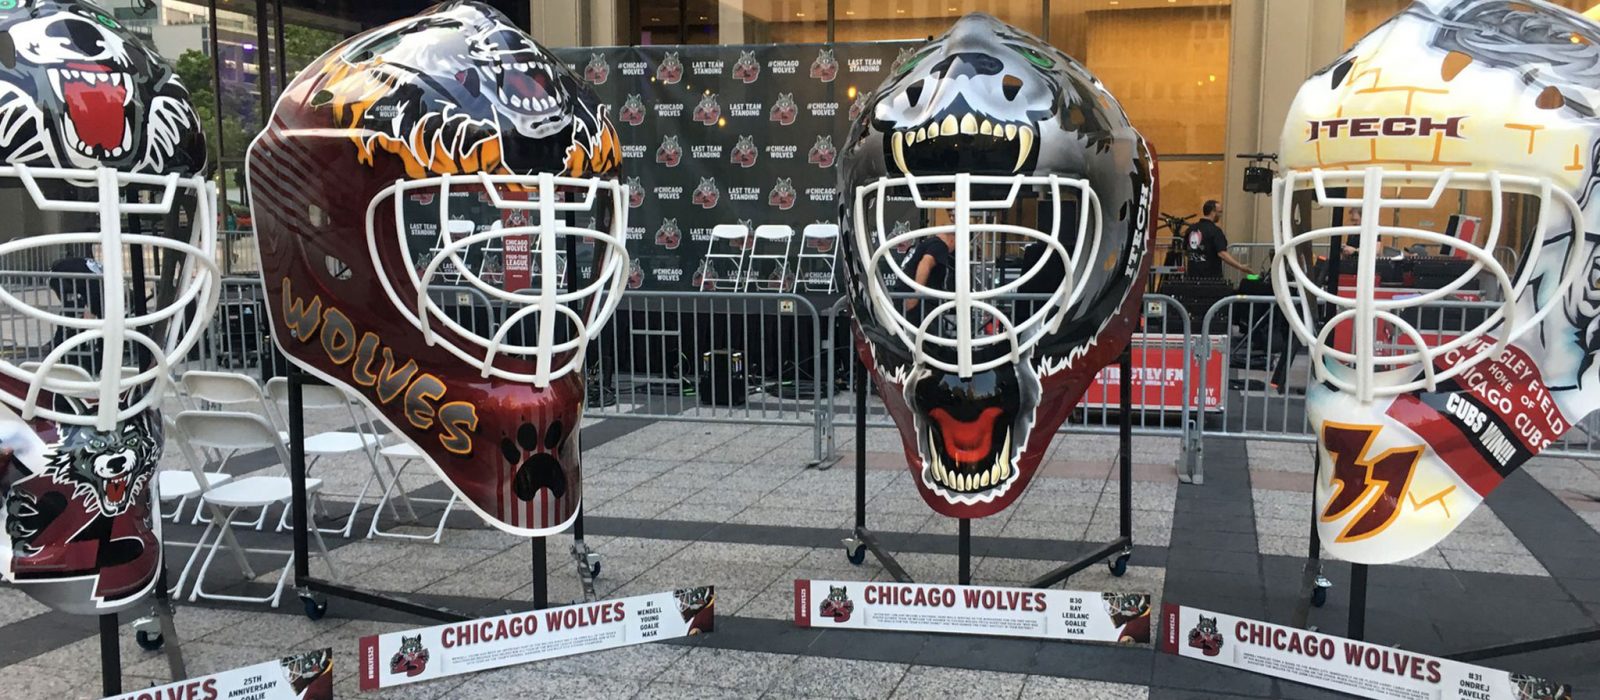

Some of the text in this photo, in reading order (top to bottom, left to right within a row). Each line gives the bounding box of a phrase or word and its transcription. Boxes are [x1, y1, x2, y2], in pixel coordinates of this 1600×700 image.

[1306, 116, 1472, 142] ITECH
[1125, 183, 1149, 278] ITECH
[282, 277, 478, 454] WOLVES
[1488, 364, 1535, 410] HOME OF
[1528, 379, 1564, 435] FIELD
[1446, 392, 1517, 466] CUBS WIN!!!
[864, 585, 1047, 612] CHICAGO WOLVES
[637, 608, 662, 616] WENDELL
[640, 615, 659, 623] YOUNG
[441, 602, 625, 649] CHICAGO WOLVES
[640, 622, 659, 631] GOALIE
[642, 630, 658, 638] MASK
[1235, 620, 1335, 660] CHICAGO
[1344, 642, 1442, 684] WOLVES
[244, 675, 262, 685] 25TH
[1460, 680, 1490, 692] ONDREJ
[1468, 672, 1482, 681] #31
[122, 678, 218, 700] LVES
[228, 680, 277, 698] ANNIVERSARY
[1459, 688, 1490, 700] PAVELEC
